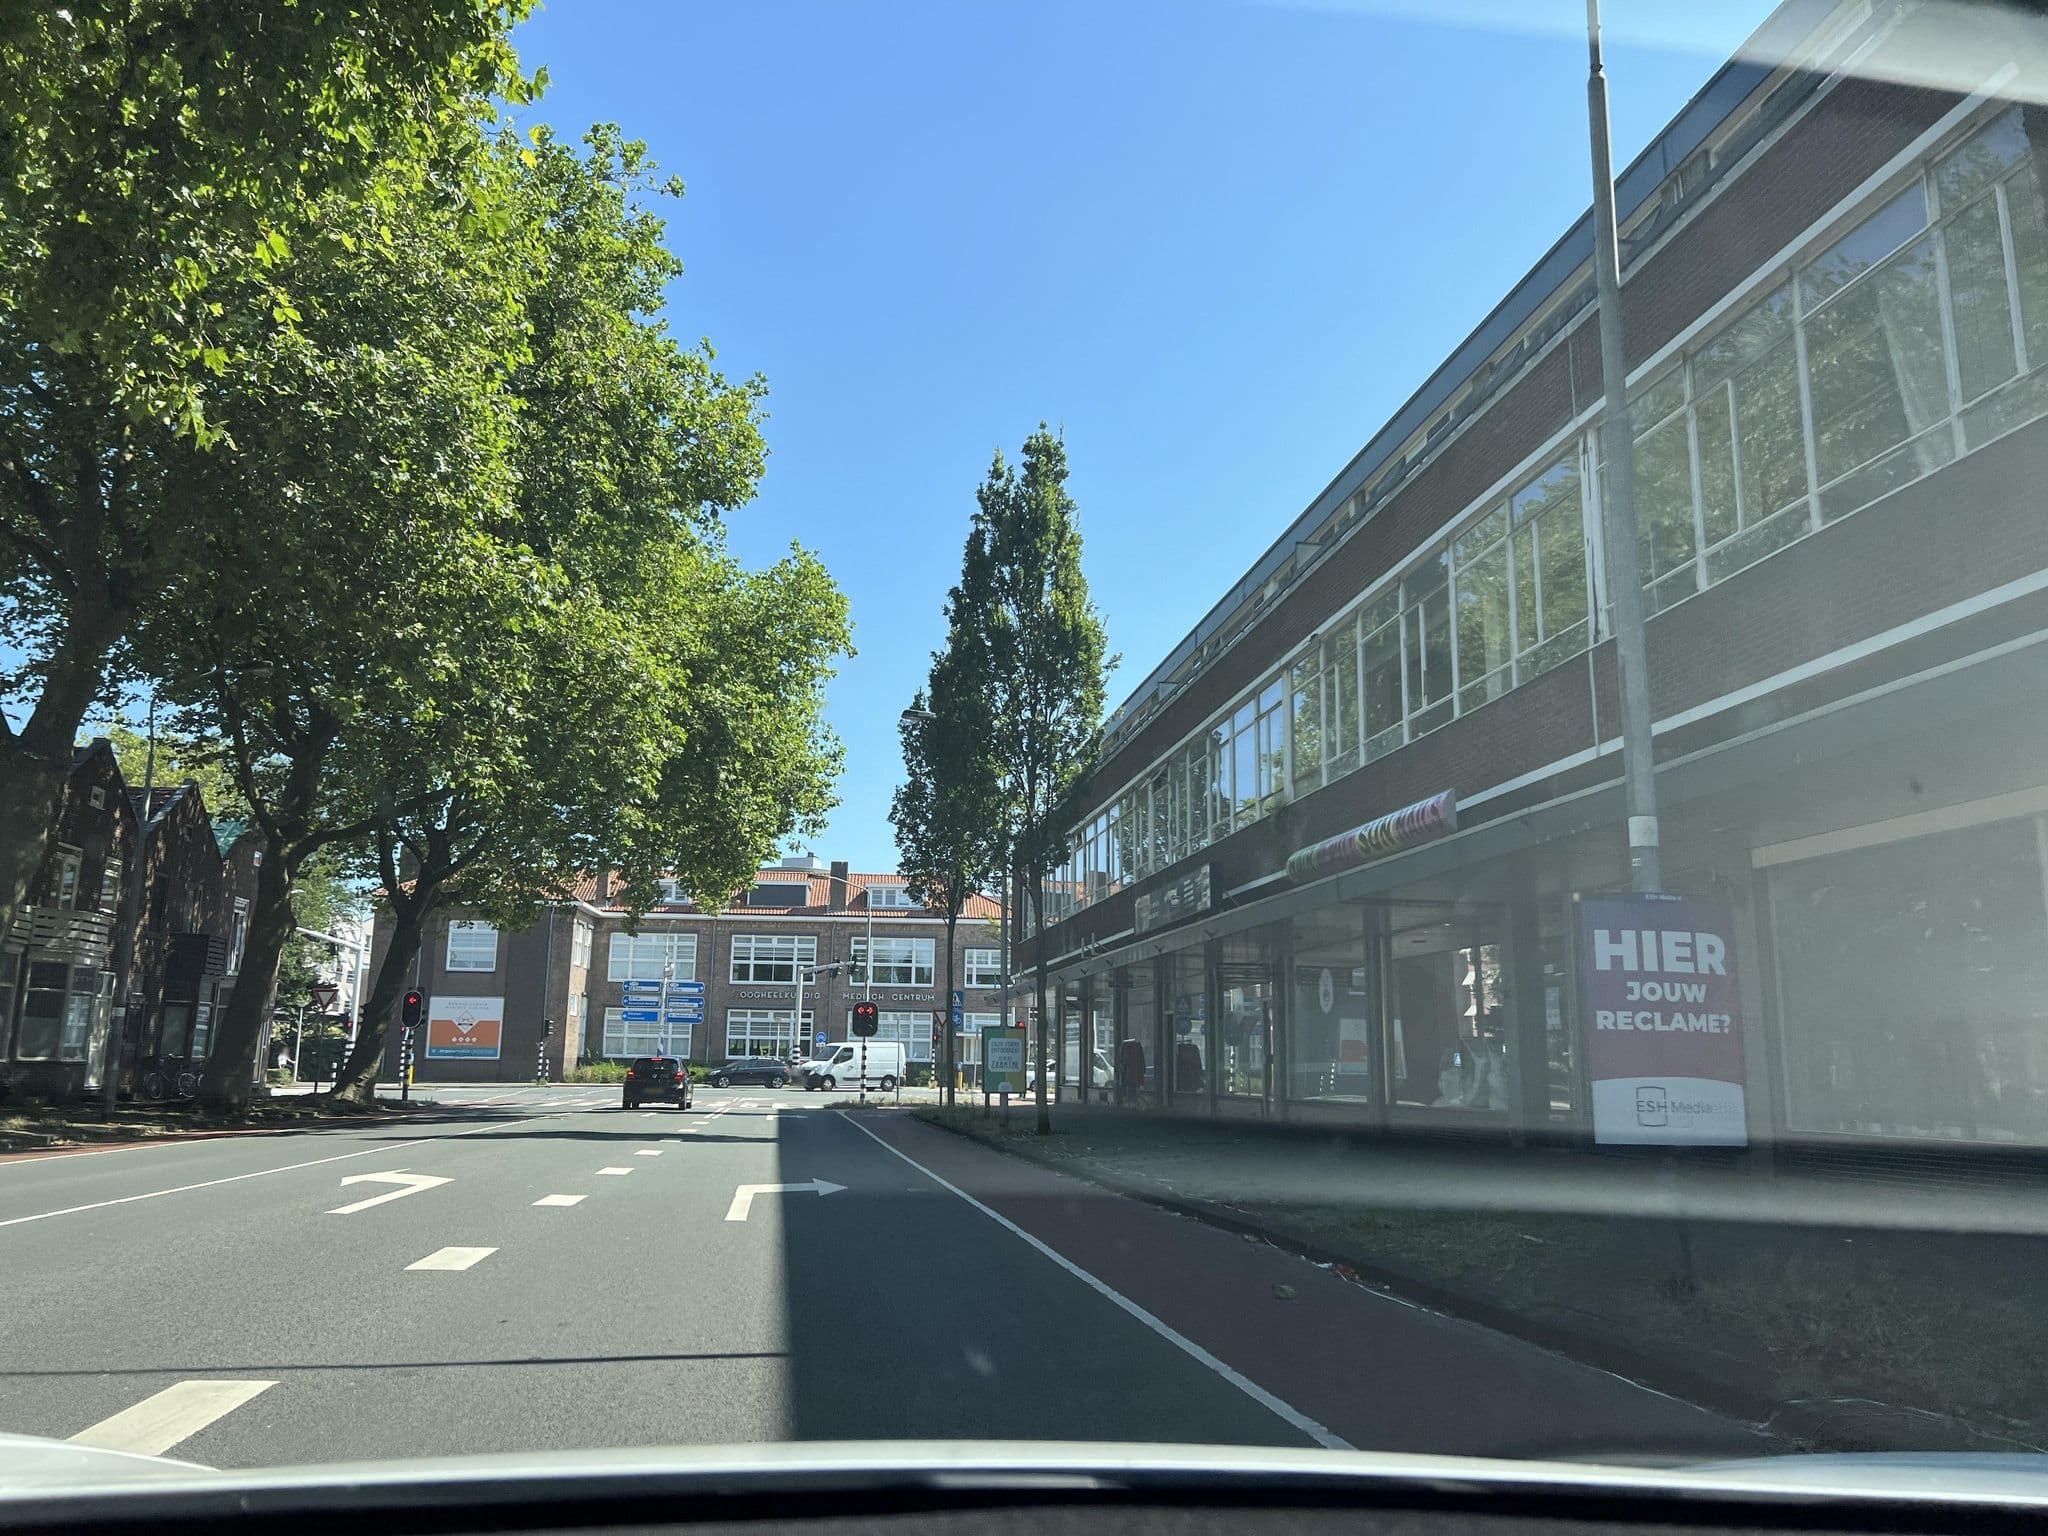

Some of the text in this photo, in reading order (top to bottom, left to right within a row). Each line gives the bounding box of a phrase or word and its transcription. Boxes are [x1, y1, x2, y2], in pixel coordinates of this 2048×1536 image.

[1594, 929, 1727, 976] HIER
[740, 991, 935, 1001] OOGHEELKUDIG MEDICH CENTRUM
[1625, 981, 1707, 1003] JOUW
[1596, 1009, 1731, 1034] RECLAME?
[1636, 1100, 1667, 1113] ESH
